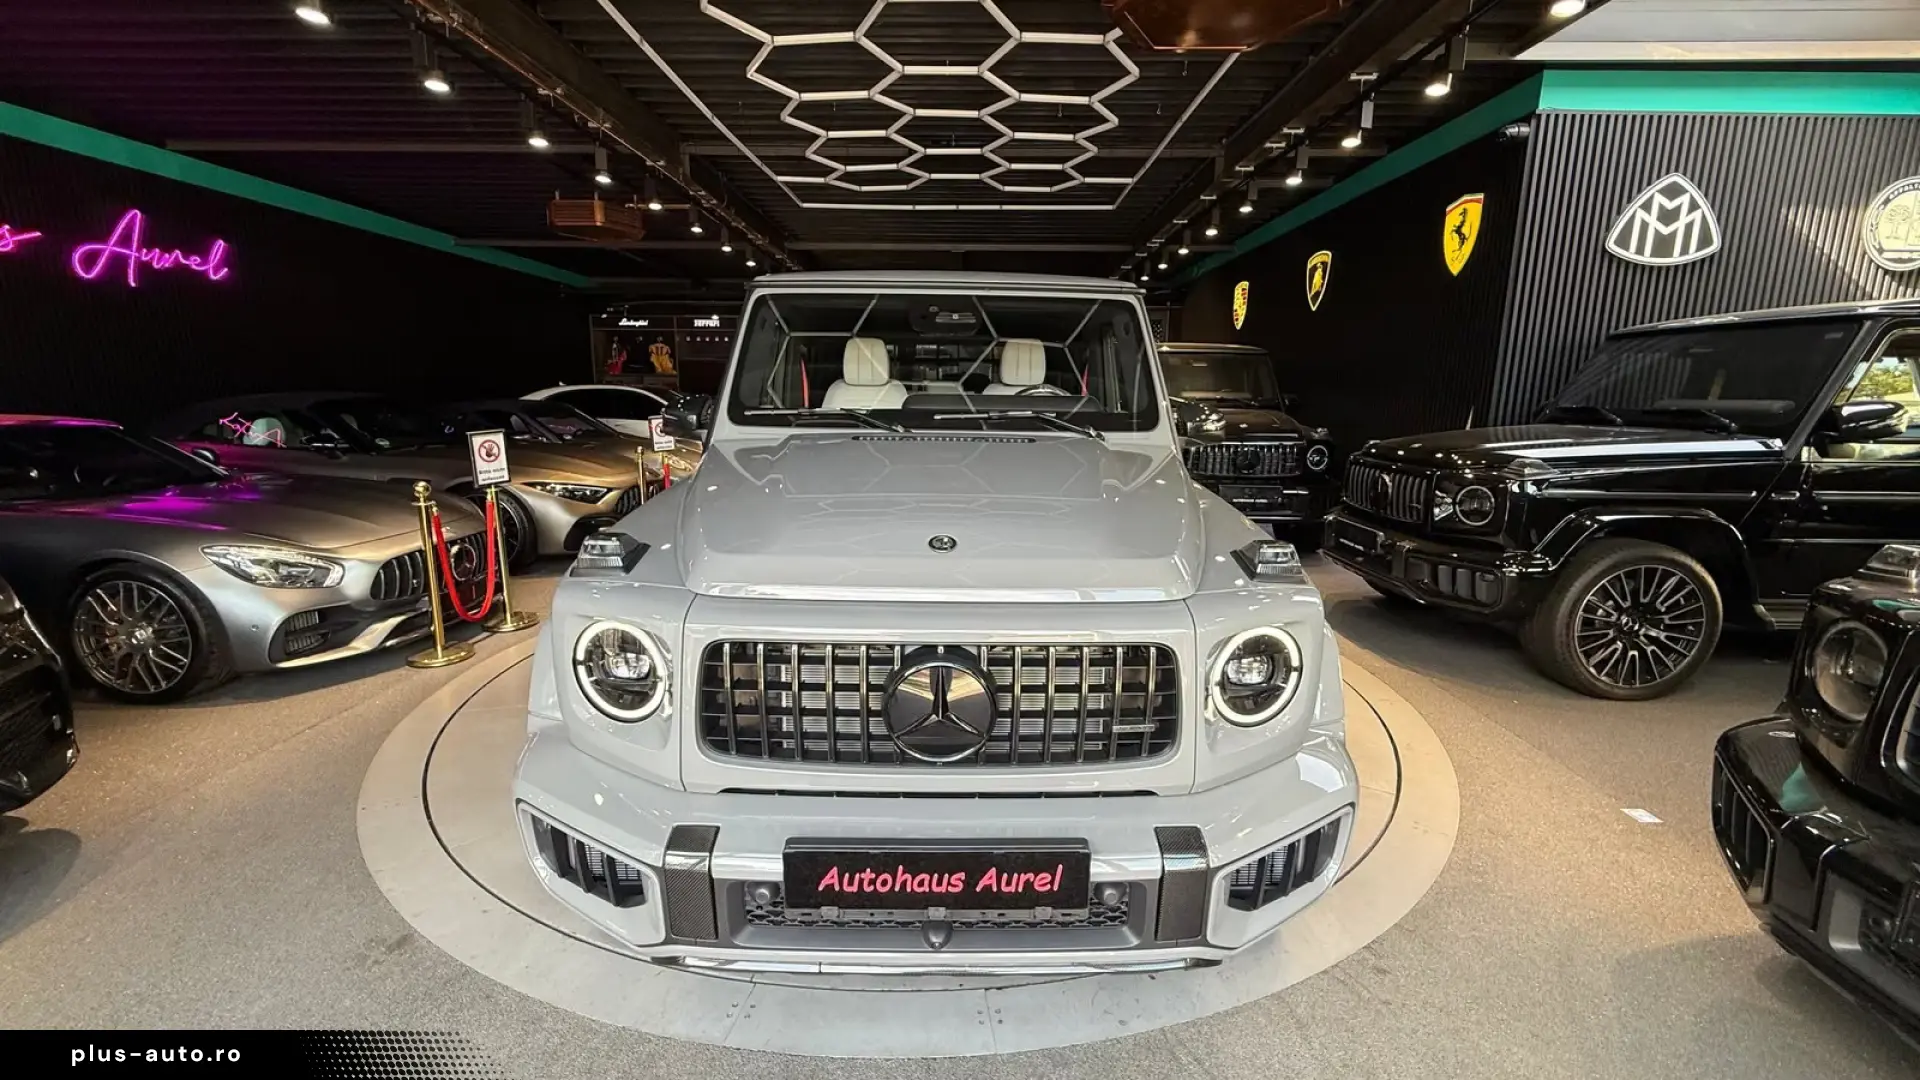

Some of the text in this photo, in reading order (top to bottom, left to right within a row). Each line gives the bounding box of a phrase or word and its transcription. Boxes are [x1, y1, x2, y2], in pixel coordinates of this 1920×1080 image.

[72, 209, 229, 287] Aurel
[817, 864, 1063, 893] Autohaus Aurel
